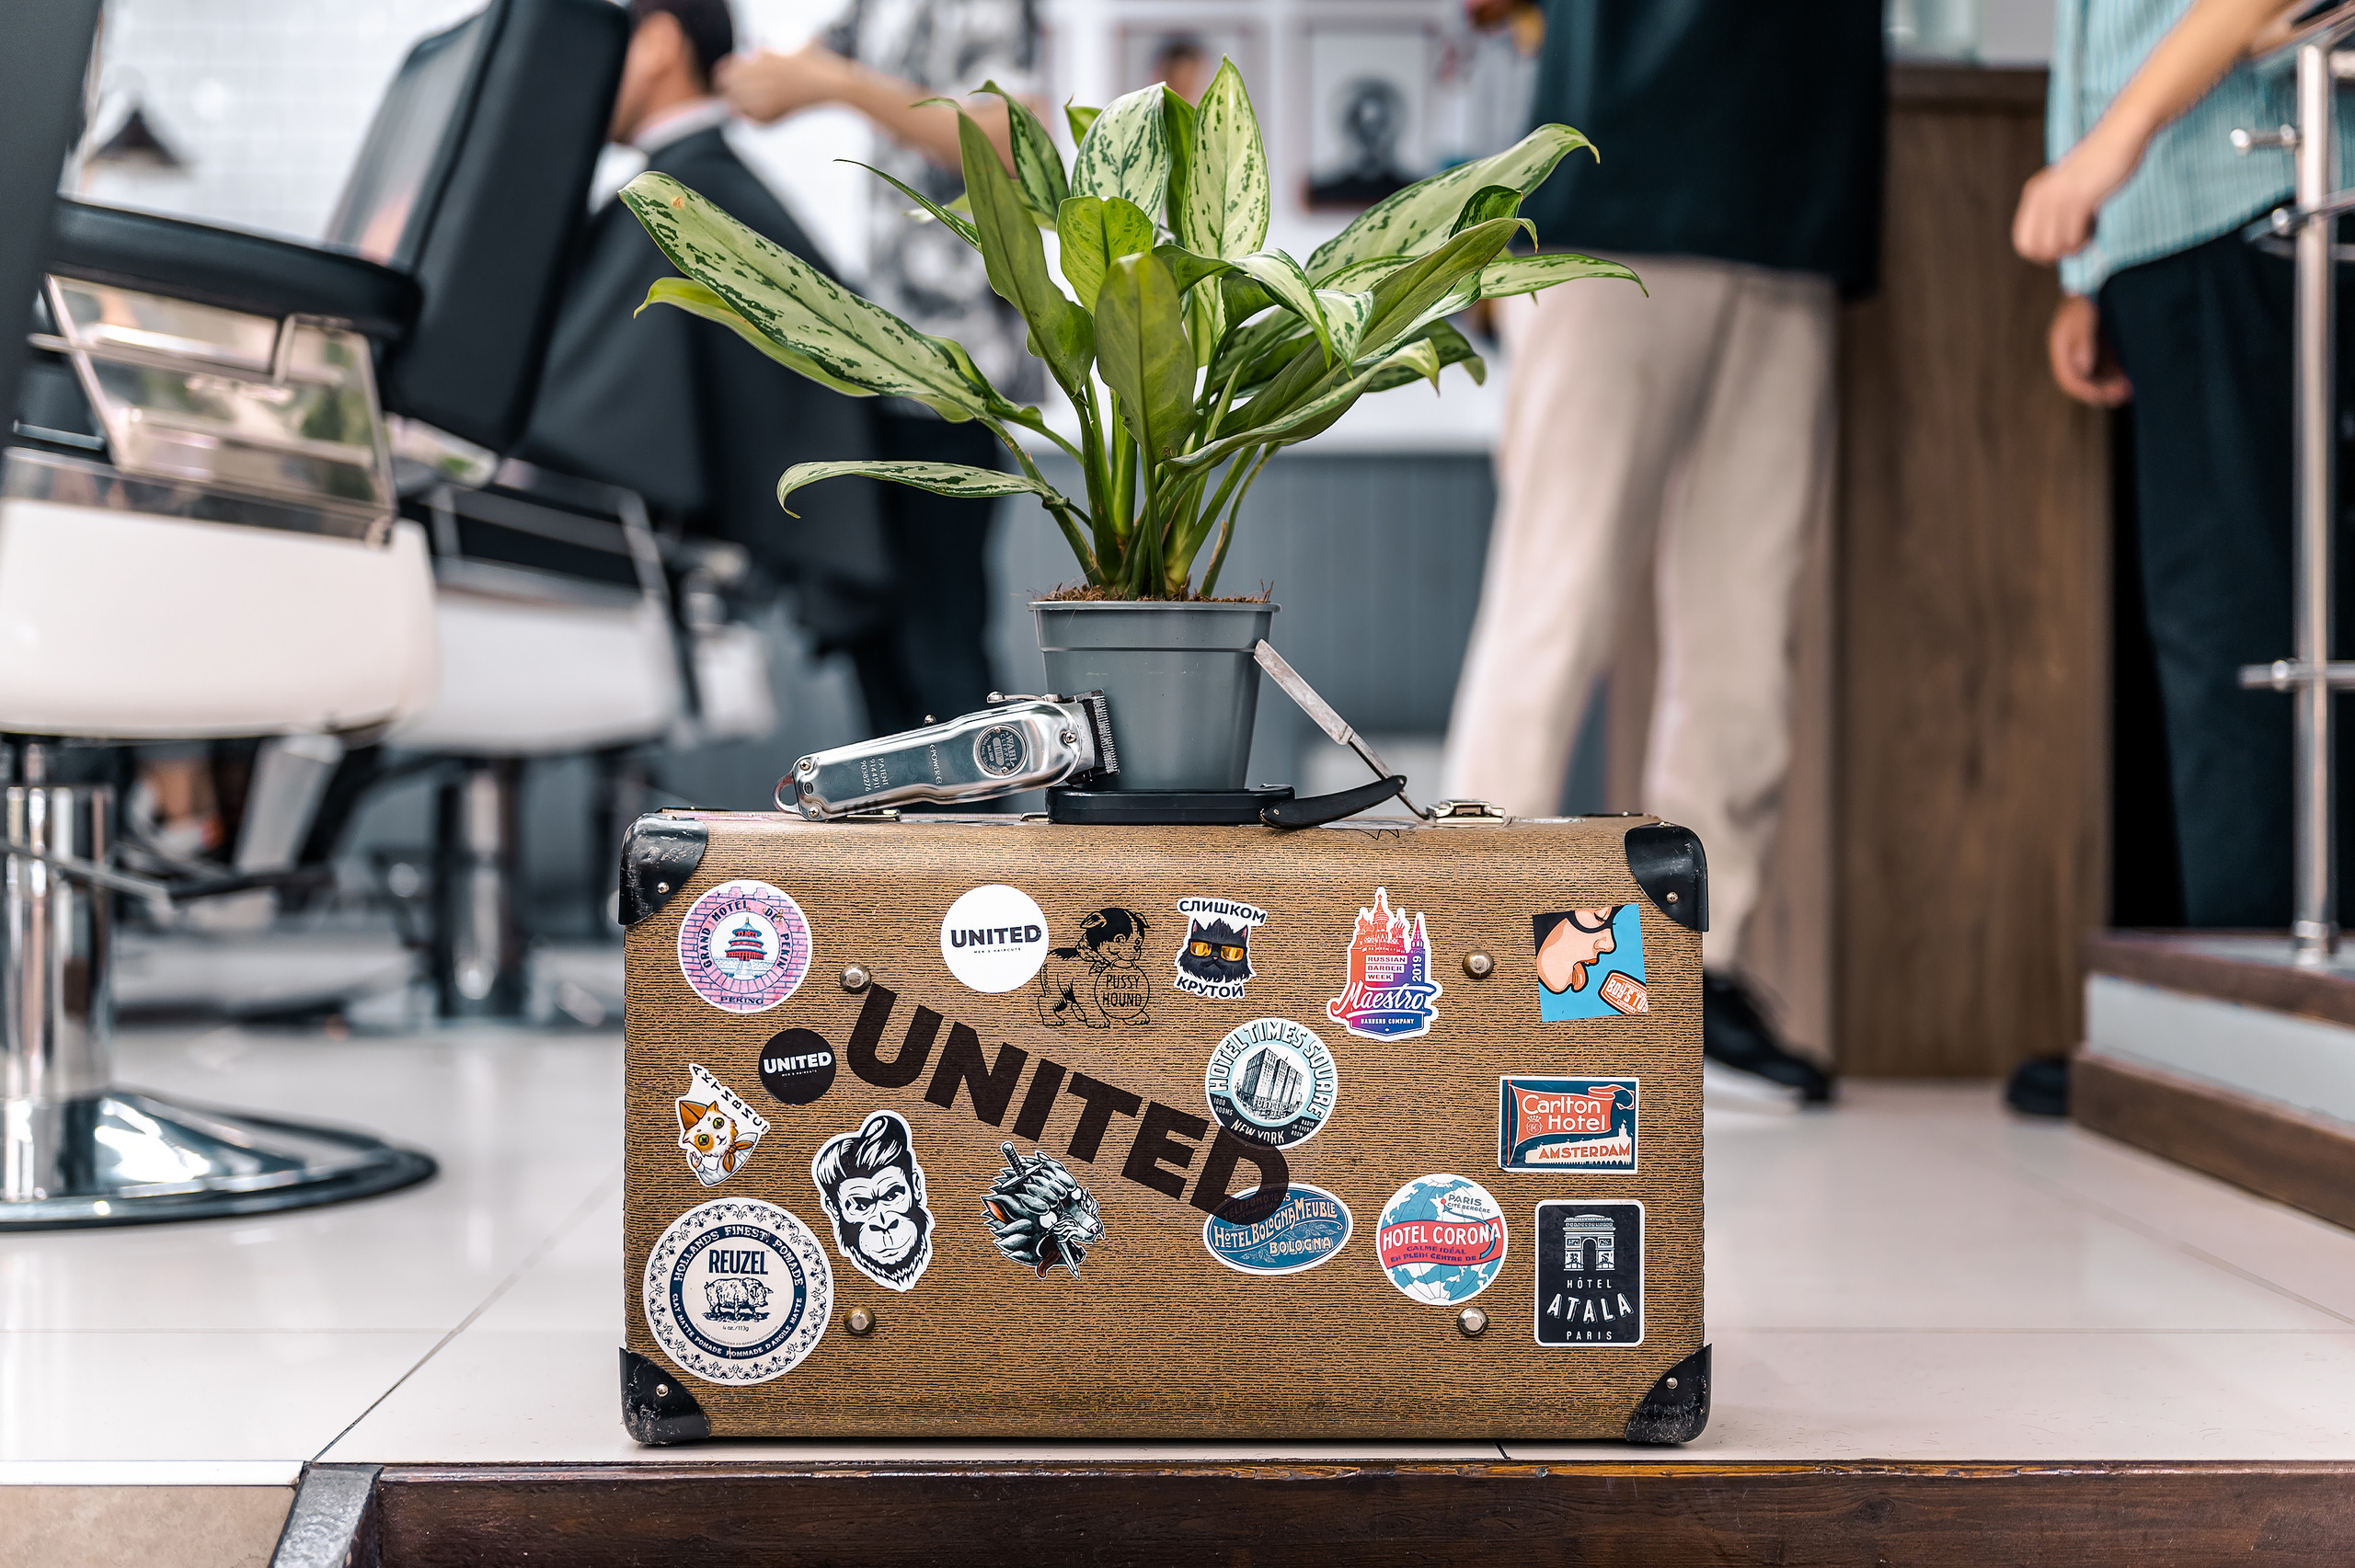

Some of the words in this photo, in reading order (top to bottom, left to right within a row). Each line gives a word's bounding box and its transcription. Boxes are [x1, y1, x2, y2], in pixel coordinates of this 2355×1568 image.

[1005, 734, 1017, 763] WAHL
[878, 757, 890, 785] PATENT
[930, 750, 940, 776] POWER
[1178, 900, 1267, 923] СЛИШКОМ
[700, 927, 713, 968] GRAND
[711, 899, 747, 922] HOTEL
[776, 933, 791, 970] PEKIN
[950, 924, 1042, 948] UNITED
[1412, 956, 1422, 982] 2019
[1106, 974, 1141, 990] PUSSY
[1177, 976, 1244, 998] КРУТОЙ
[720, 996, 764, 1004] PEKING
[1104, 993, 1143, 1008] HOUND
[1333, 980, 1435, 1015] Maestro
[764, 1051, 833, 1074] UNITED
[1209, 1034, 1249, 1092] HOTEL
[1244, 1021, 1308, 1048] TIMES
[1303, 1040, 1334, 1119] SQUARE
[846, 982, 1289, 1226] UNITED
[1215, 1106, 1234, 1116] ROOMS
[1522, 1094, 1601, 1115] Carlton
[1231, 1119, 1256, 1136] NEW
[1257, 1130, 1285, 1144] YORK
[1548, 1114, 1605, 1131] Hotel
[1539, 1143, 1630, 1160] AMSTERDAM
[1448, 1194, 1482, 1207] PARIS
[1462, 1205, 1491, 1214] BERGÈRE
[1269, 1237, 1334, 1256] BOLOGNA
[1383, 1225, 1428, 1252] HOTEL
[1433, 1222, 1501, 1245] CORONA
[673, 1230, 719, 1282] HOLLANDS
[724, 1226, 768, 1241] FINEST
[772, 1238, 804, 1287] POMADE
[1430, 1253, 1462, 1262] CENTRE
[1440, 1246, 1466, 1254] IDÉAL
[708, 1249, 769, 1275] REUZEL
[1567, 1276, 1612, 1288] HÔTEL
[672, 1293, 681, 1314] CLAY
[790, 1297, 803, 1324] MATTE
[1546, 1293, 1634, 1323] ATALA
[676, 1314, 694, 1338] MATTE
[1567, 1331, 1612, 1340] PARIS
[695, 1337, 722, 1355] POMADE
[726, 1346, 764, 1357] POMMADE
